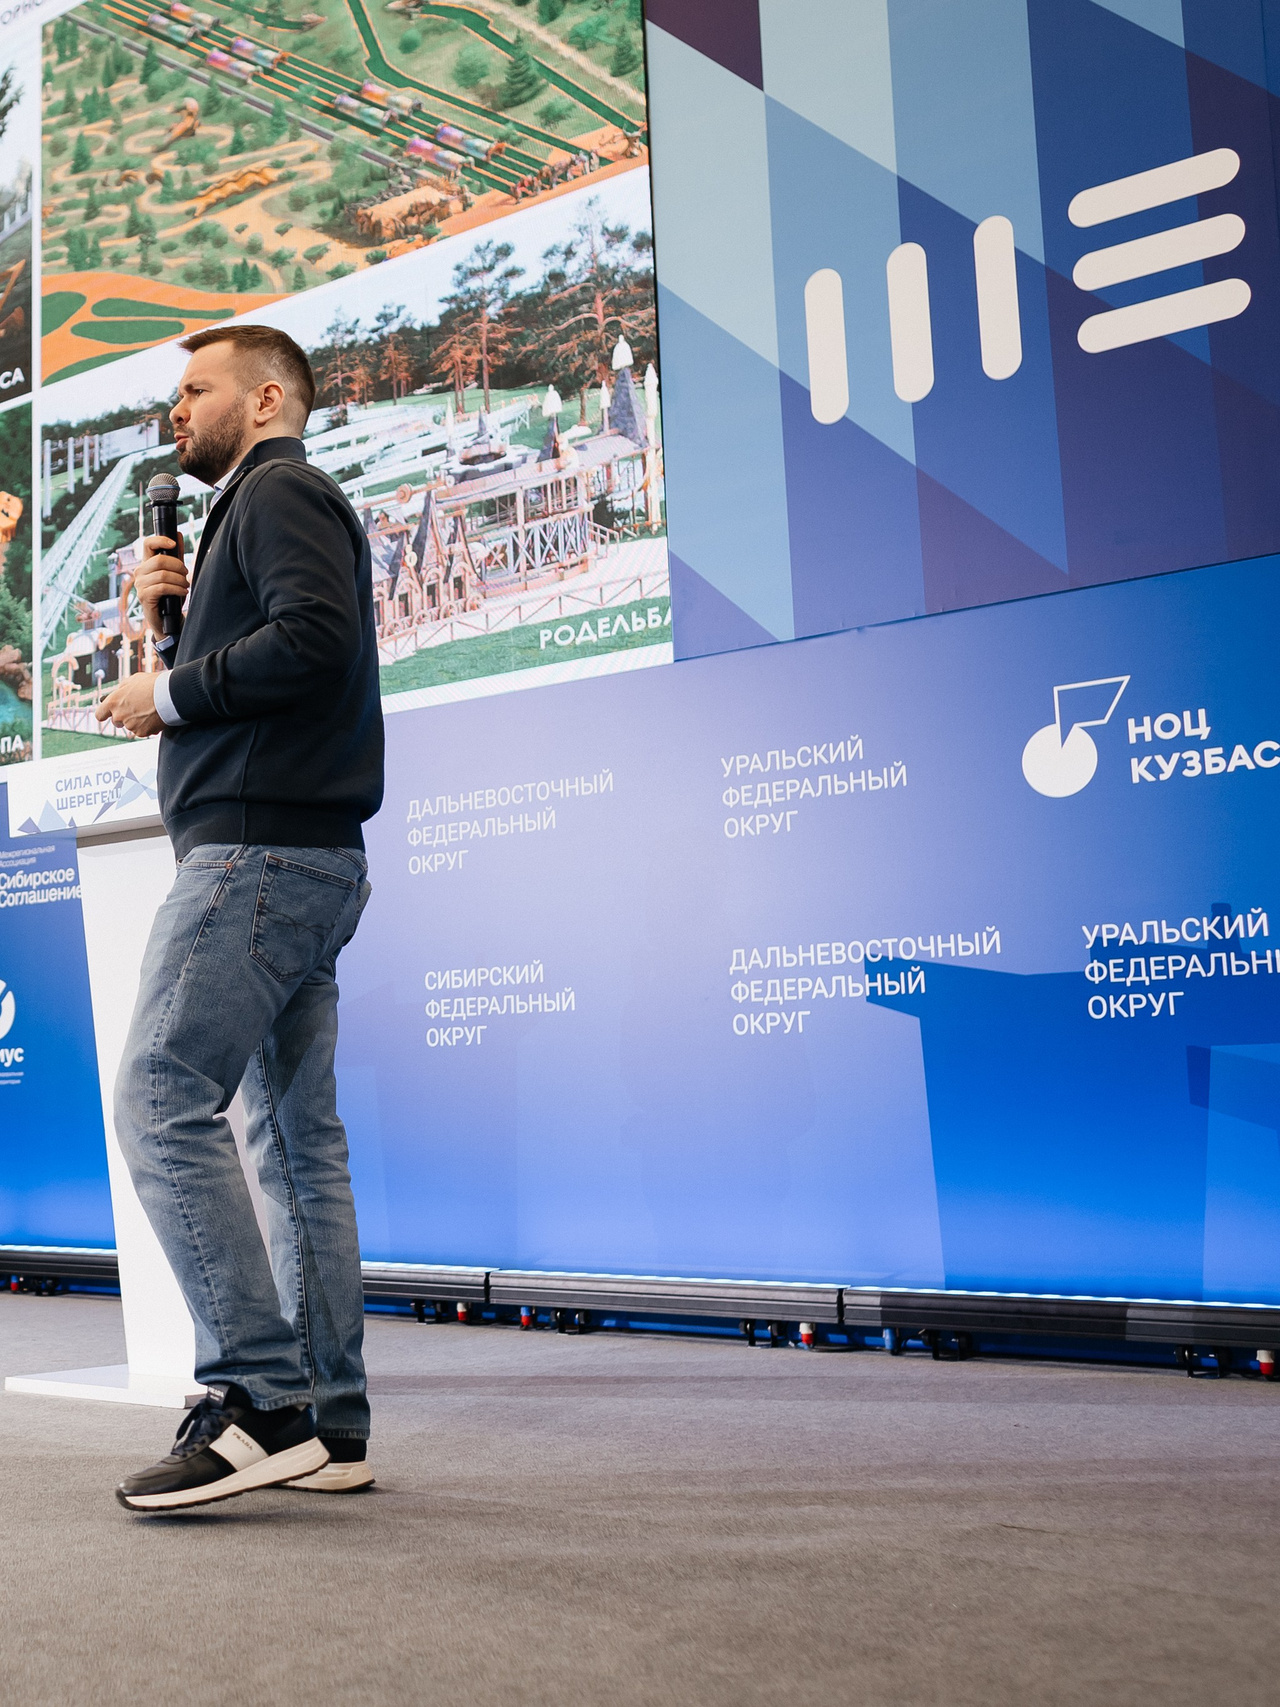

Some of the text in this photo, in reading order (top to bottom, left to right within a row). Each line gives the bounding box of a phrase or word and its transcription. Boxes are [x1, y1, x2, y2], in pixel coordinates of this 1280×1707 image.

[1127, 708, 1211, 744] НОЦ
[720, 734, 864, 778] УРАЛЬСКИЙ
[1130, 740, 1280, 784] КУЗБАС
[55, 769, 121, 793] СИЛА ГОР
[407, 768, 614, 823] ДАЛЬНЕВОСТОЧНЫЙ
[722, 760, 908, 809] ФЕДЕРАЛЬНЫЙ
[407, 805, 557, 848] ФЕДЕРАЛЬНЫЙ
[723, 810, 798, 839] ОКРУГ
[408, 850, 469, 875] ОКРУГ
[1082, 907, 1269, 949] УРАЛЬСКИЙ
[729, 925, 1001, 976] ДАЛЬНЕВОСТОЧНЫЙ
[424, 959, 544, 991] СИБИРСКИЙ
[730, 965, 926, 1006] ФЕДЕРАЛЬНЫЙ
[425, 987, 576, 1022] ФЕДЕРАЛЬНЫЙ
[1087, 991, 1184, 1020] ОКРУГ
[426, 1025, 487, 1047] ОКРУГ
[732, 1010, 811, 1036] ОКРУГ
